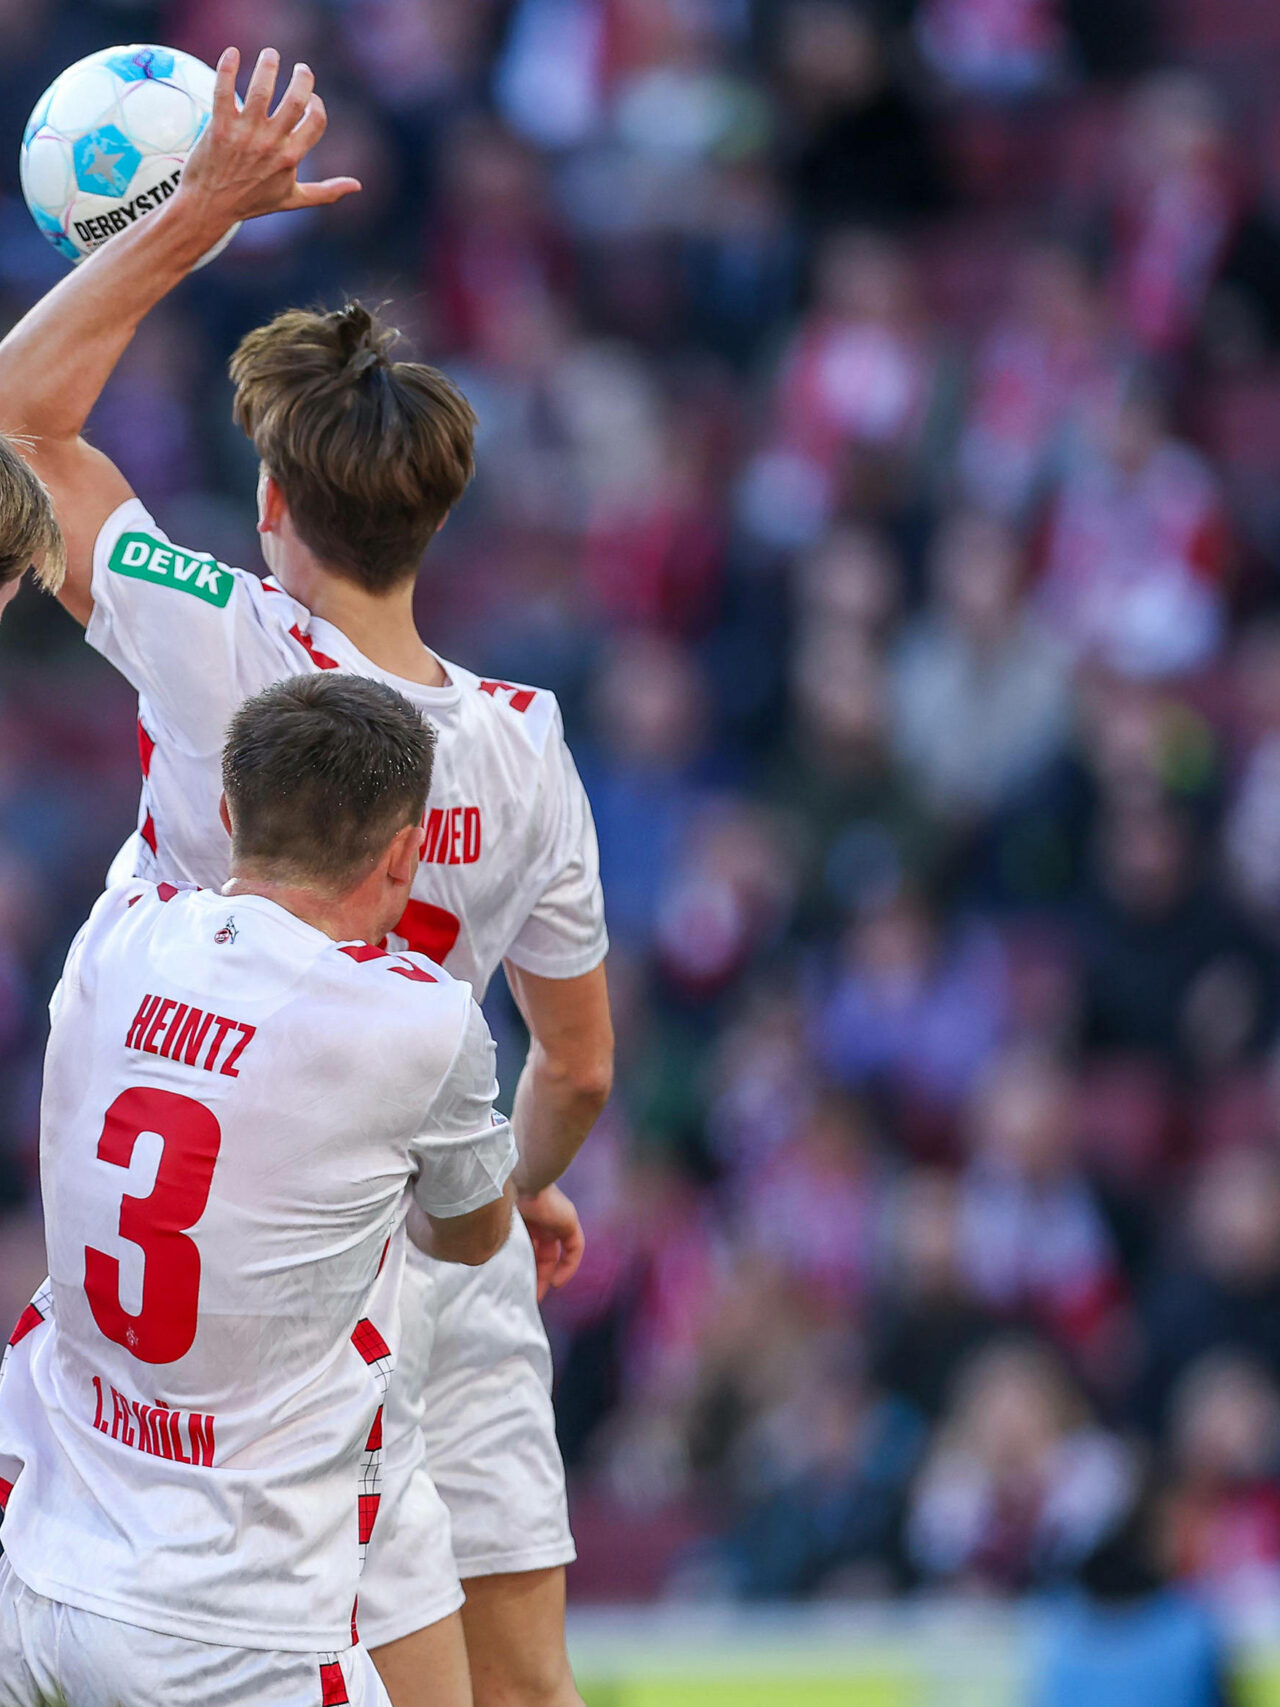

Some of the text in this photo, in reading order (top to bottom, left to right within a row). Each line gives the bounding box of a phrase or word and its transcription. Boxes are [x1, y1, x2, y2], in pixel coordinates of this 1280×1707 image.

[121, 541, 223, 595] DEVK
[124, 994, 256, 1077] HEINTZ
[83, 1086, 221, 1365] 3
[132, 1398, 215, 1467] KÖLN
